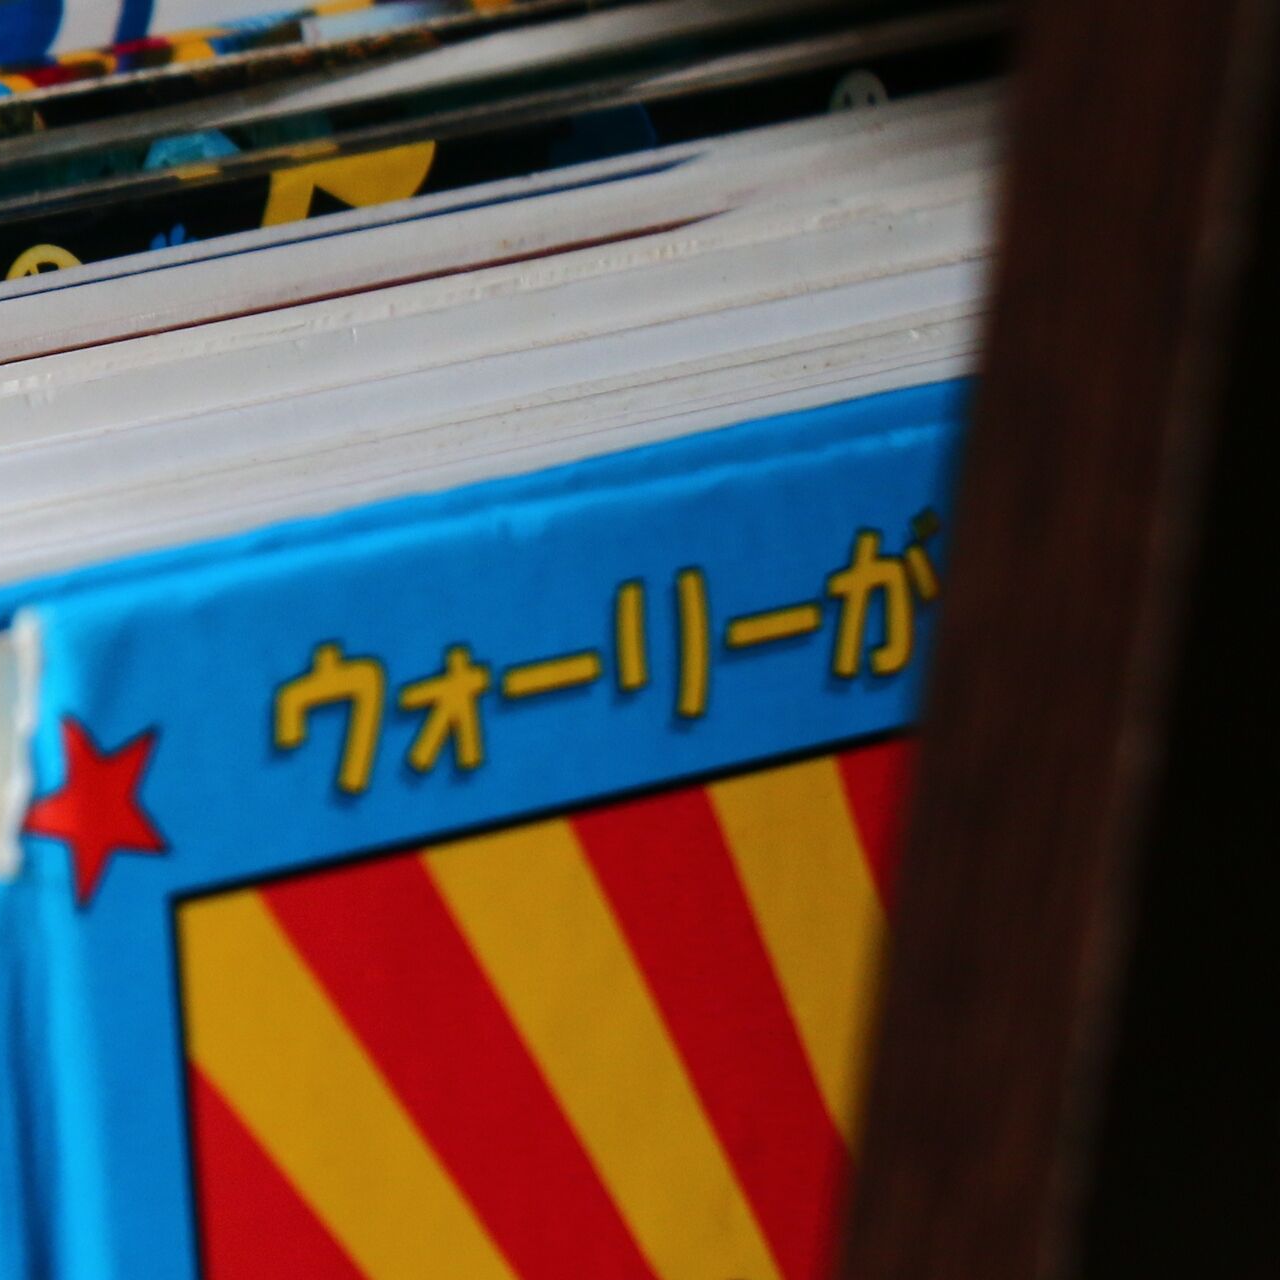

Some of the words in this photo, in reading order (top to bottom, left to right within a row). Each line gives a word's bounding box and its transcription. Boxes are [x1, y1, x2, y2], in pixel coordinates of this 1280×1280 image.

[273, 506, 939, 795] ウォーリーが
